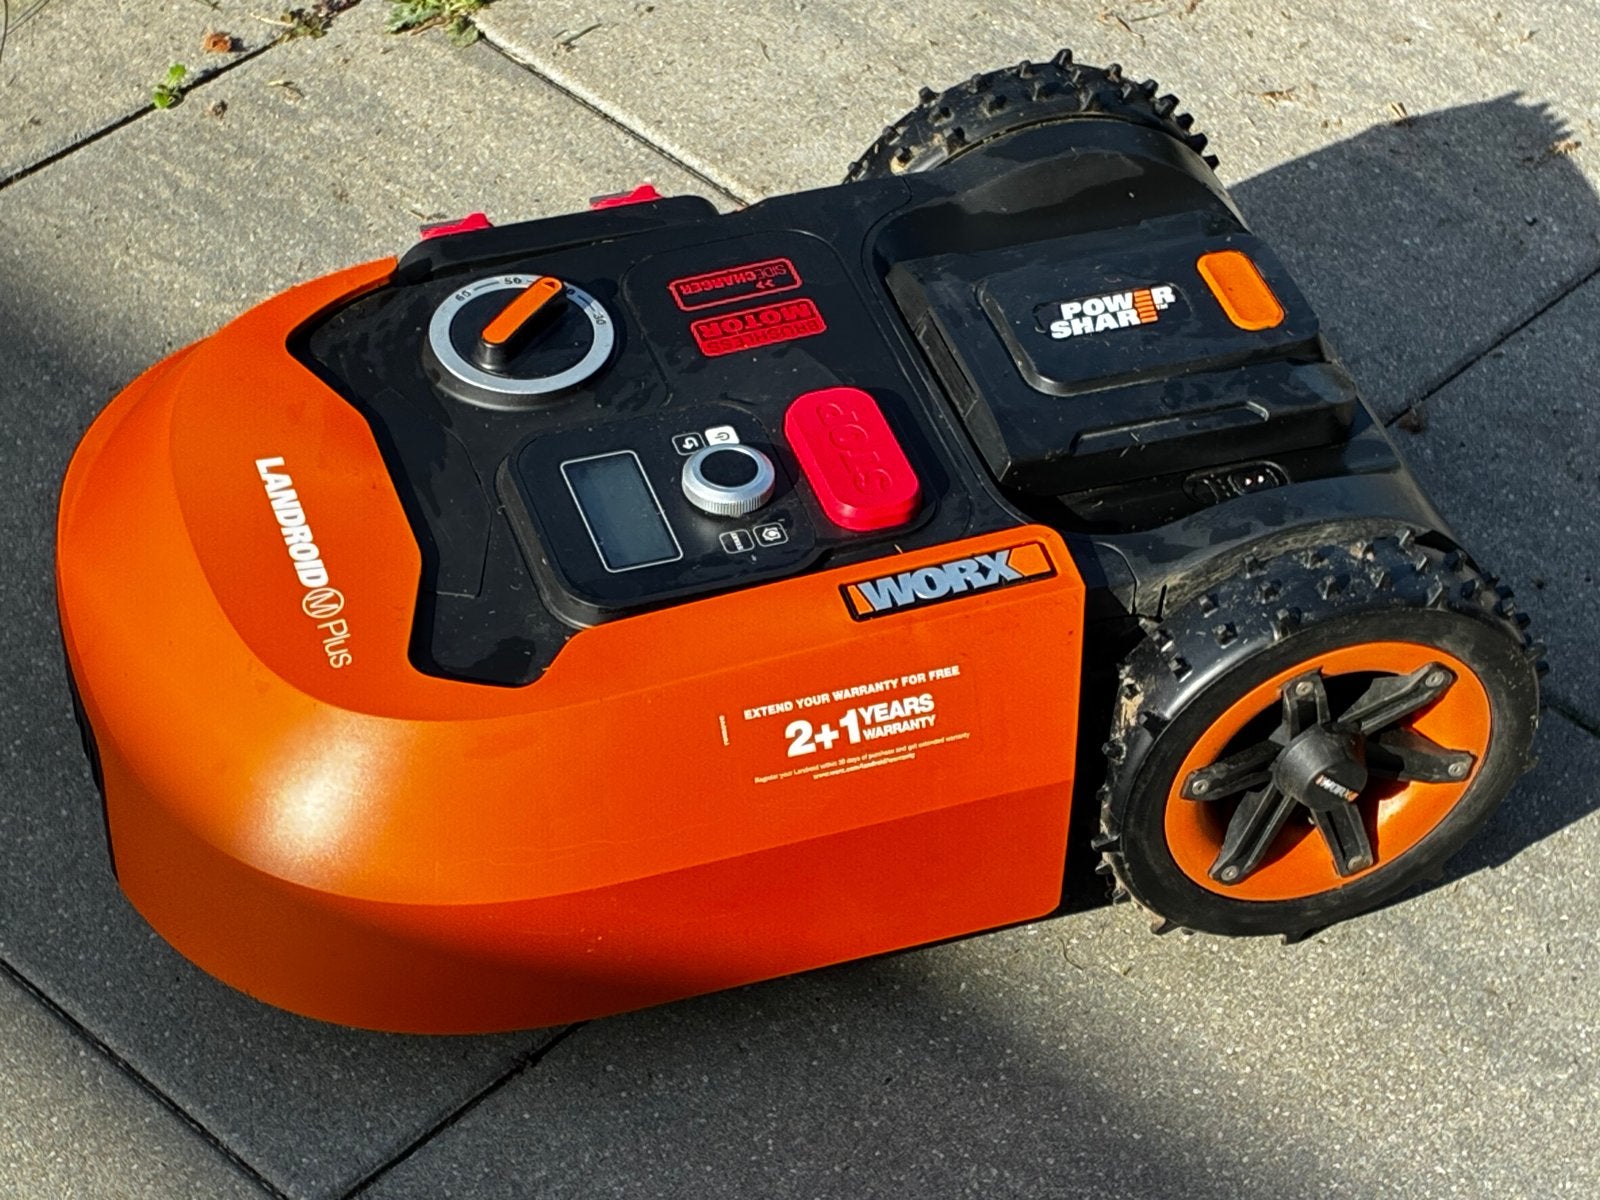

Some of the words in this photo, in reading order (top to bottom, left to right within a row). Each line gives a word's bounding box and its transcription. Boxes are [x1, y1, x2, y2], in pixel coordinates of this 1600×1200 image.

[455, 290, 472, 302] 60
[504, 277, 522, 285] 50
[593, 313, 607, 326] 30
[700, 303, 812, 338] MOTOR
[1060, 286, 1176, 320] POWER
[705, 320, 820, 352] BRUSHLESS
[1050, 304, 1158, 339] SHARE
[816, 403, 893, 494] STOP
[255, 456, 329, 588] LANDROID
[857, 550, 1024, 611] WORX
[303, 589, 343, 618] M
[317, 619, 352, 668] Plus
[743, 701, 794, 720] EXTEND
[796, 693, 831, 710] YOUR
[832, 678, 899, 701] WARRANTY
[901, 673, 926, 688] FOR
[928, 665, 961, 681] FREE
[785, 708, 861, 758] 2+1
[857, 693, 935, 726] YEARS
[862, 714, 936, 741] WARRANTY
